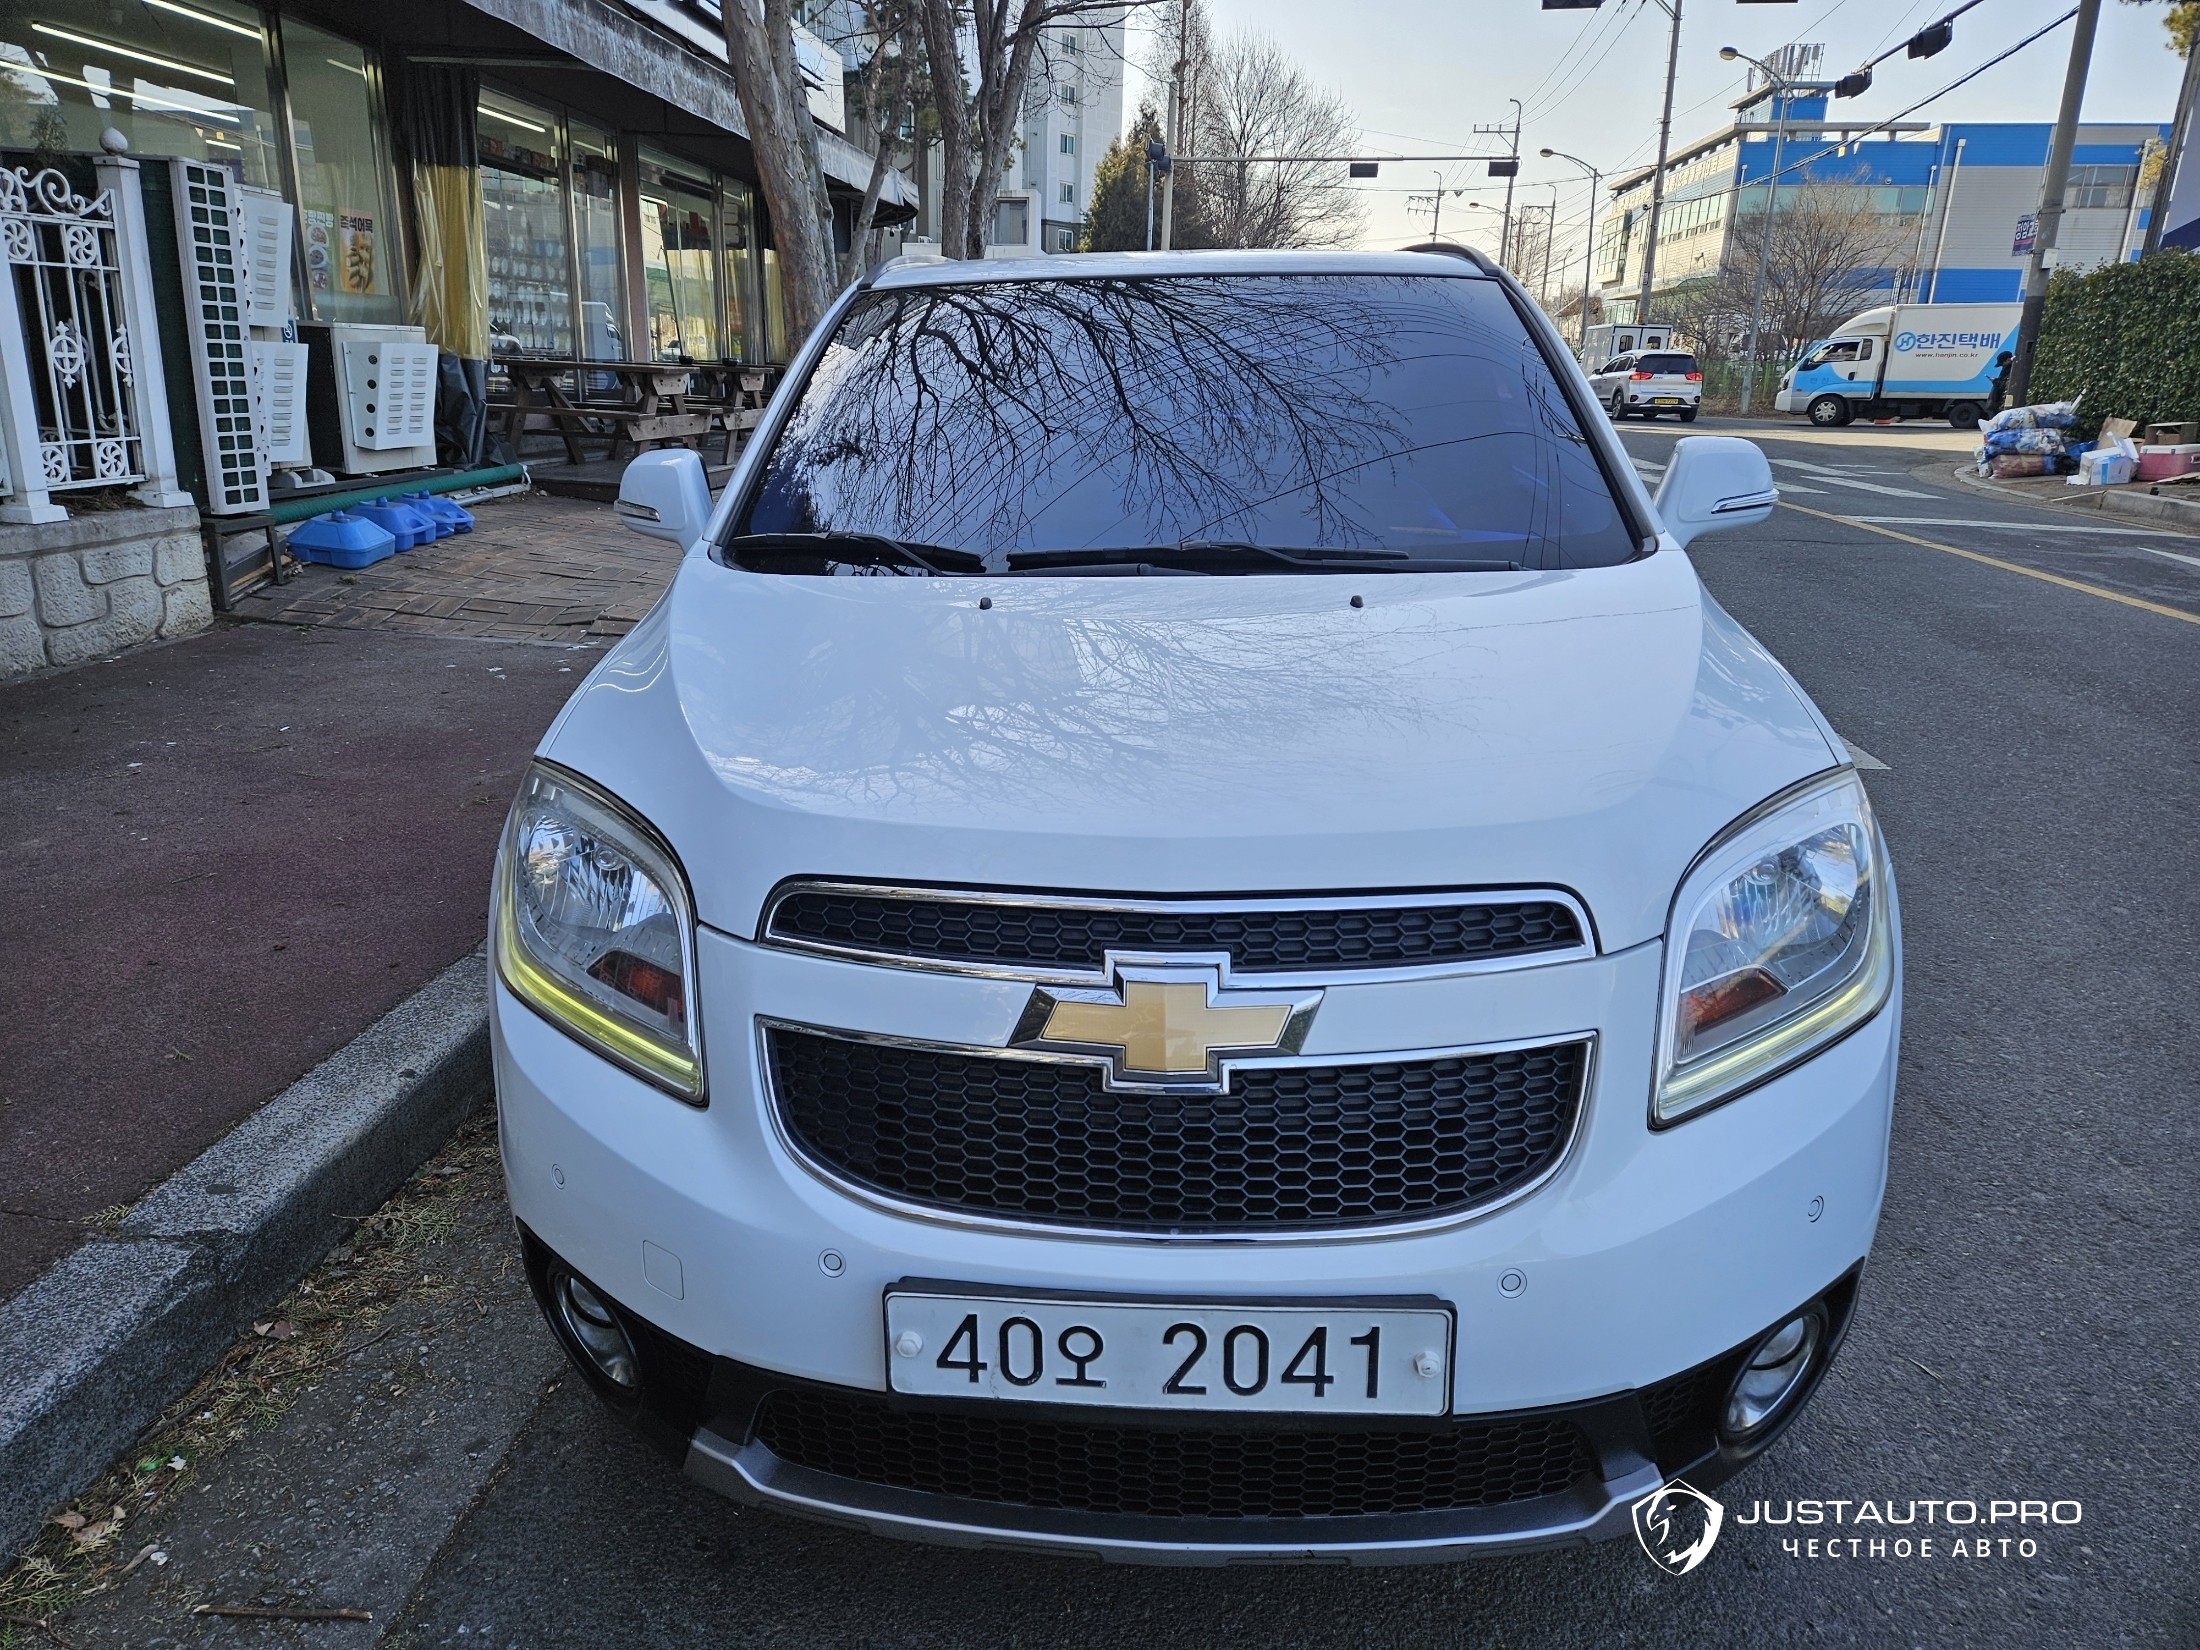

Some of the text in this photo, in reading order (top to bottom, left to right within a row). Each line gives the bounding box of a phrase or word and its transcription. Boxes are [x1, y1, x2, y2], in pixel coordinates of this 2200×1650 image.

[340, 214, 373, 234] 즉석어묵
[1916, 333, 2001, 349] 한진택배
[936, 1313, 1381, 1398] 40오 2041
